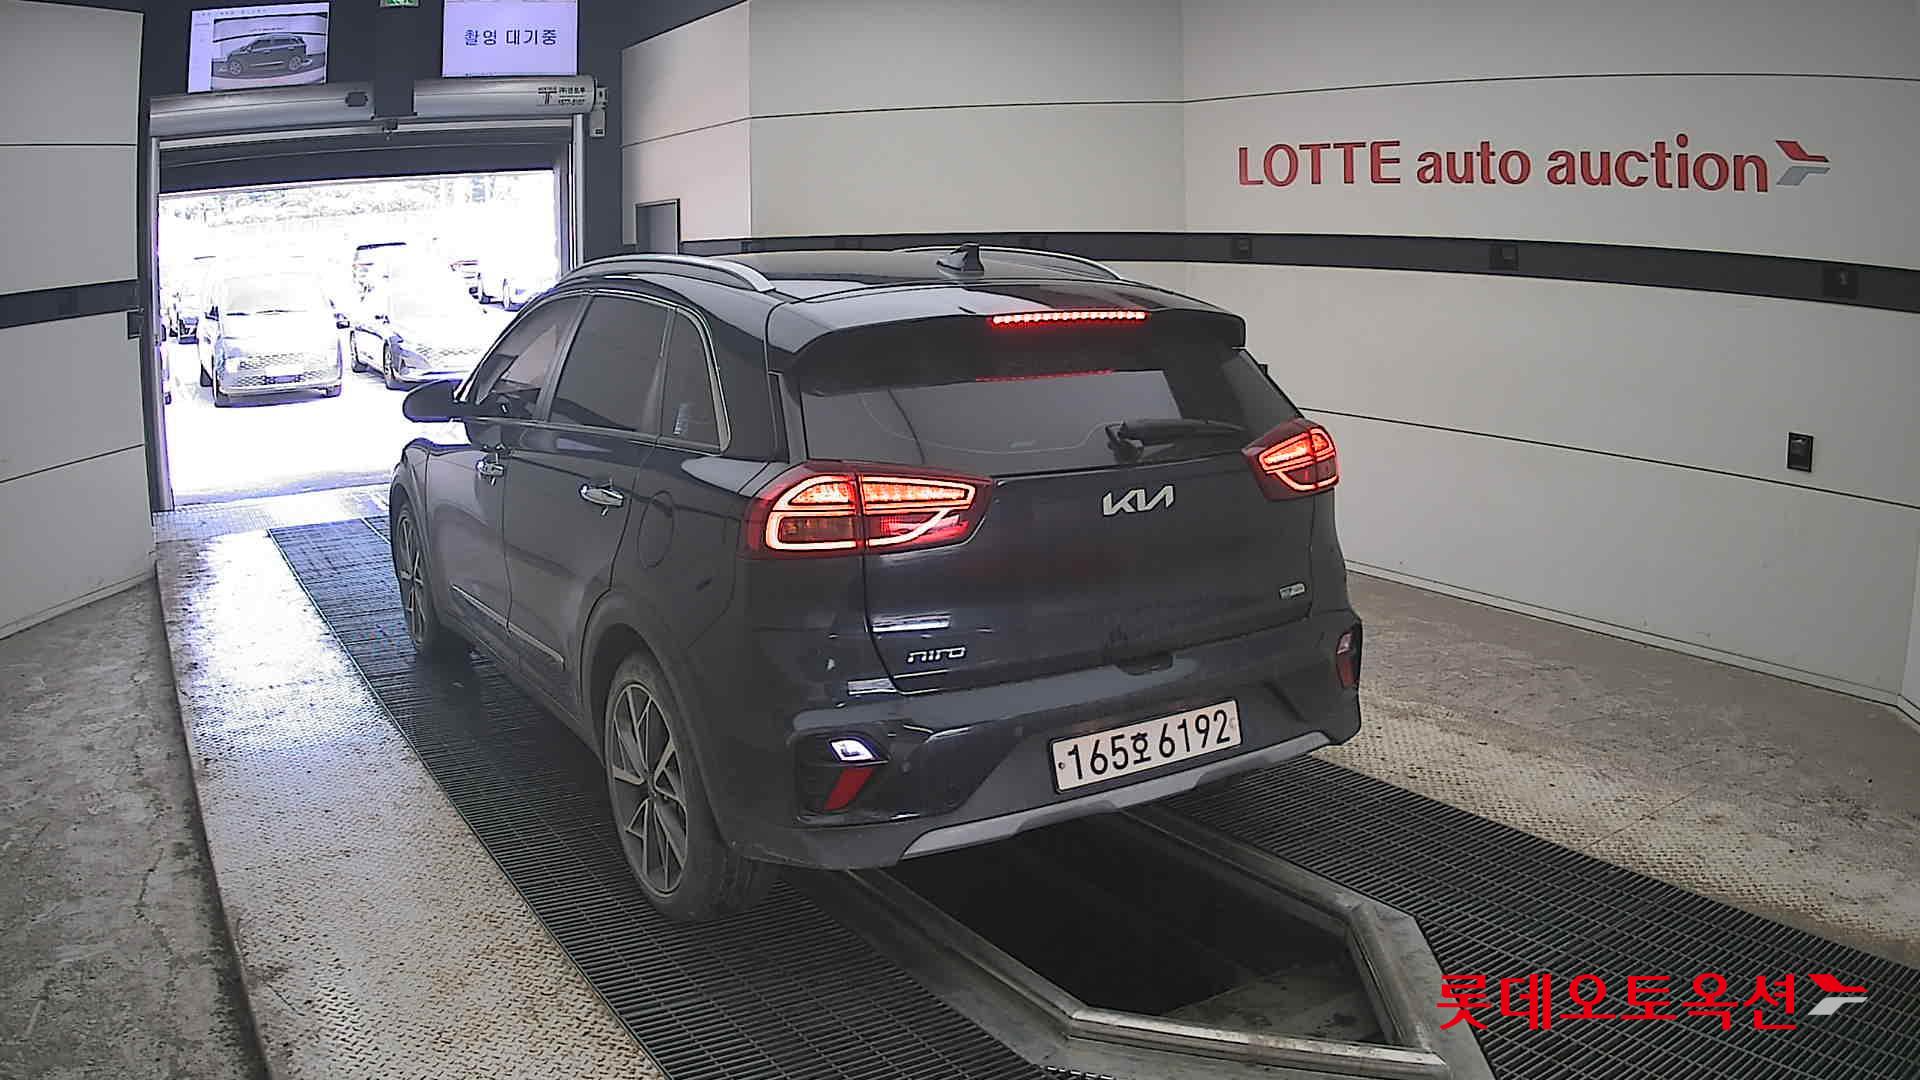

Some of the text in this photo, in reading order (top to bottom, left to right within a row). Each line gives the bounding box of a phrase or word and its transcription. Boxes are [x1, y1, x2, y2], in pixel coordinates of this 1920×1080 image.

[505, 29, 557, 46] 대기중
[1239, 134, 1769, 193] LOTTE auto auction
